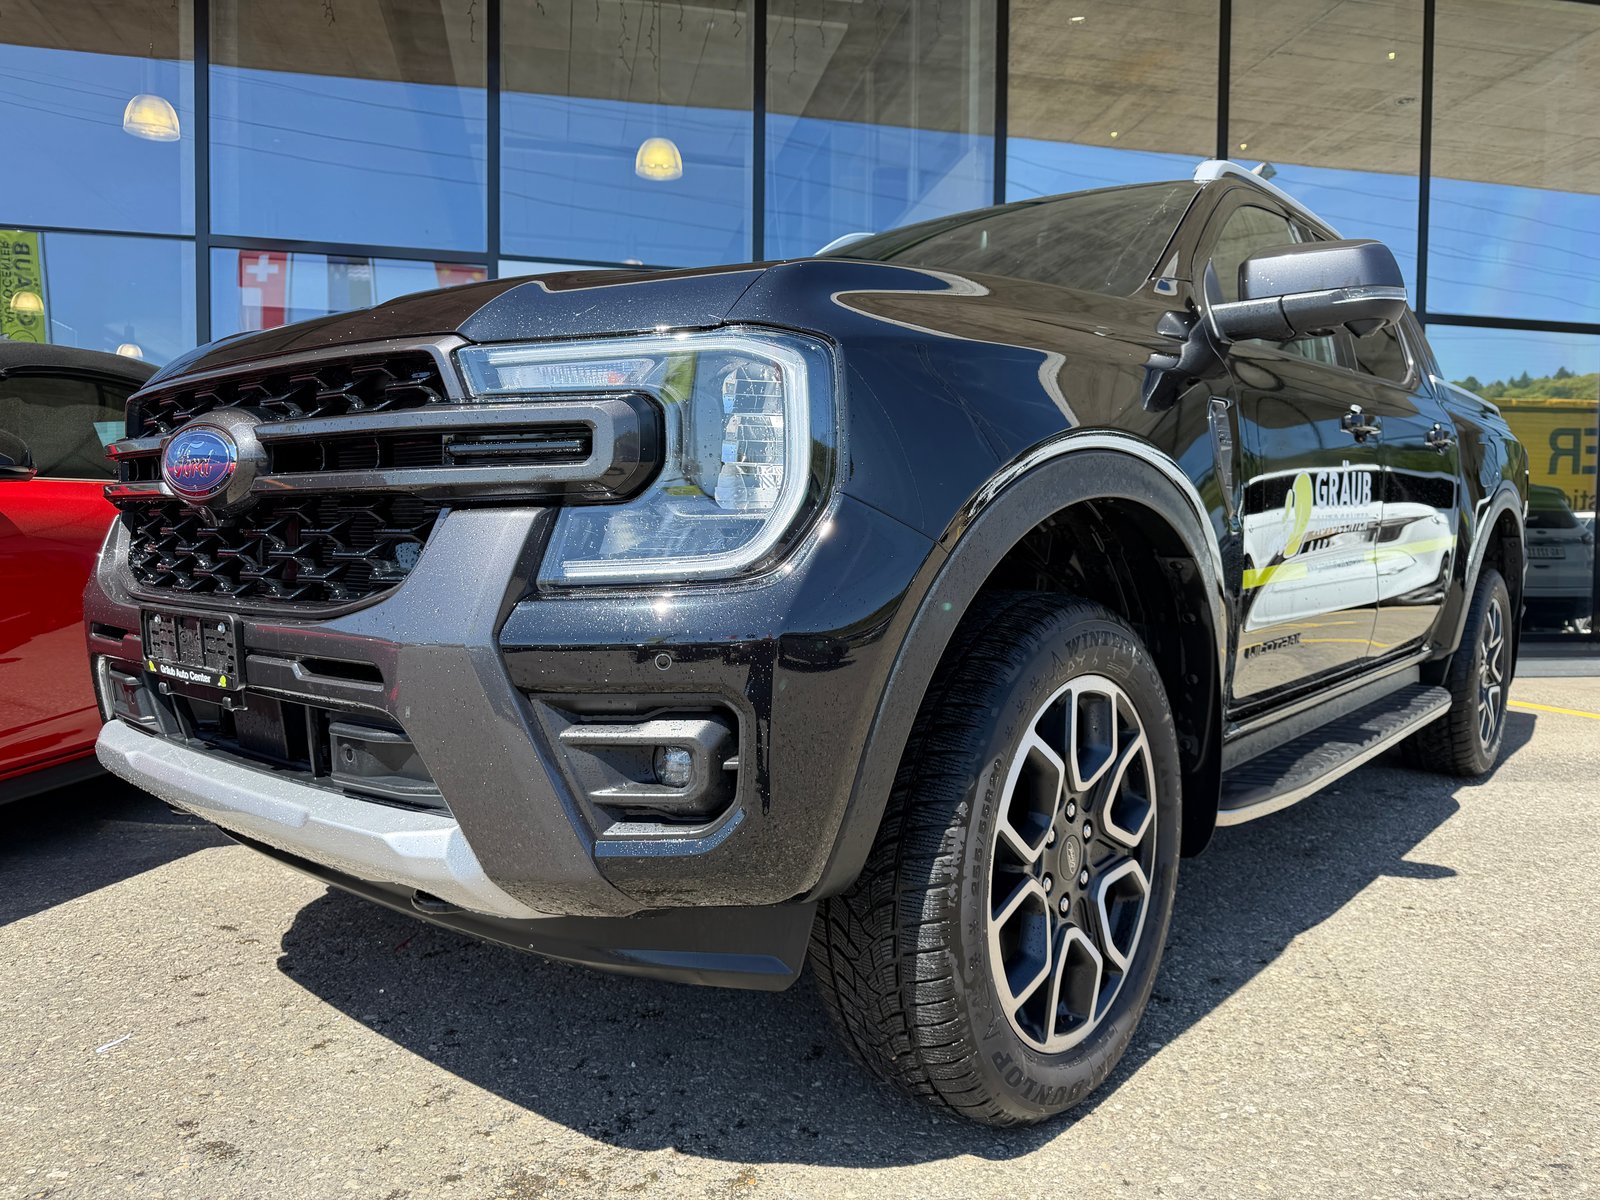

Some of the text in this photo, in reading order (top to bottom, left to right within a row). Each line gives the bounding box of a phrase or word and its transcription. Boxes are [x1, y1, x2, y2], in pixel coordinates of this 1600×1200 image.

[173, 441, 215, 478] Ford
[1315, 460, 1372, 508] GRÄUB
[176, 668, 189, 680] Auto
[189, 671, 211, 684] Center
[991, 1050, 1086, 1106] DUNLOP
